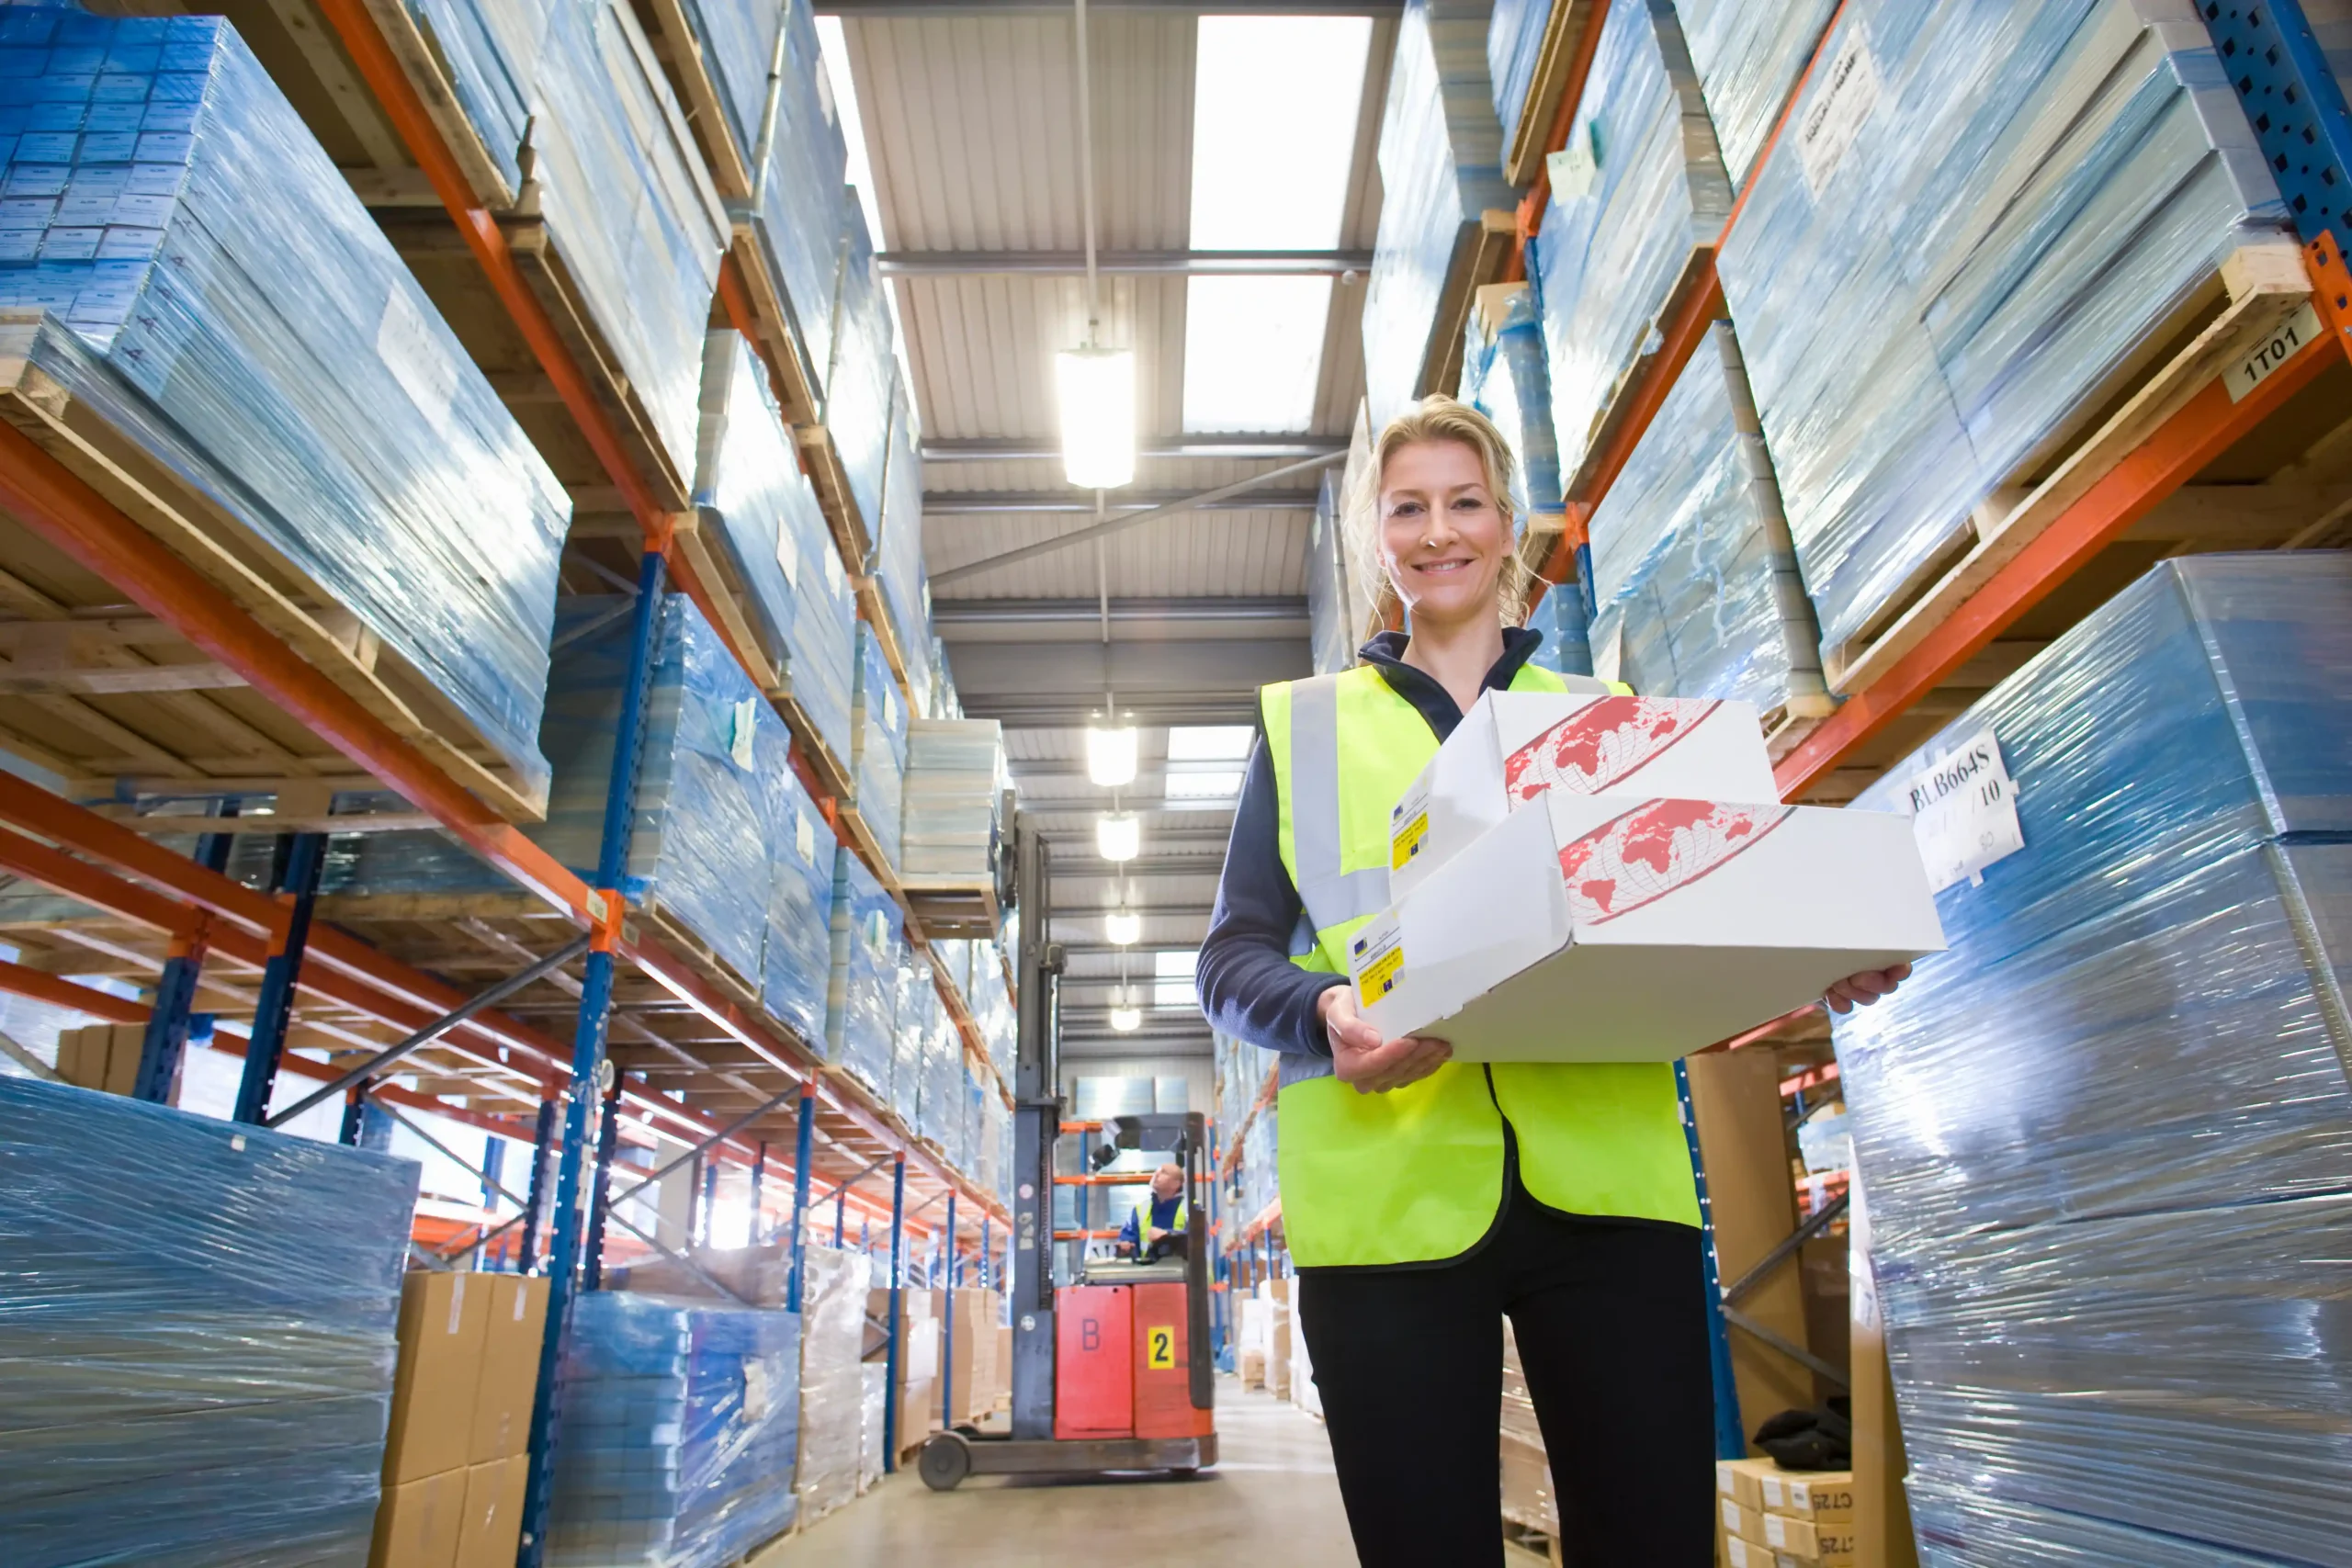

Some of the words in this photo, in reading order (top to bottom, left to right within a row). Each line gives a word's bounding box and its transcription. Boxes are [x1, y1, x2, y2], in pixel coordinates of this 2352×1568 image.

[2244, 327, 2300, 381] 1T01
[1909, 743, 1992, 813] BLB664S
[1081, 1318, 1100, 1351] B
[1154, 1333, 1169, 1362] 2
